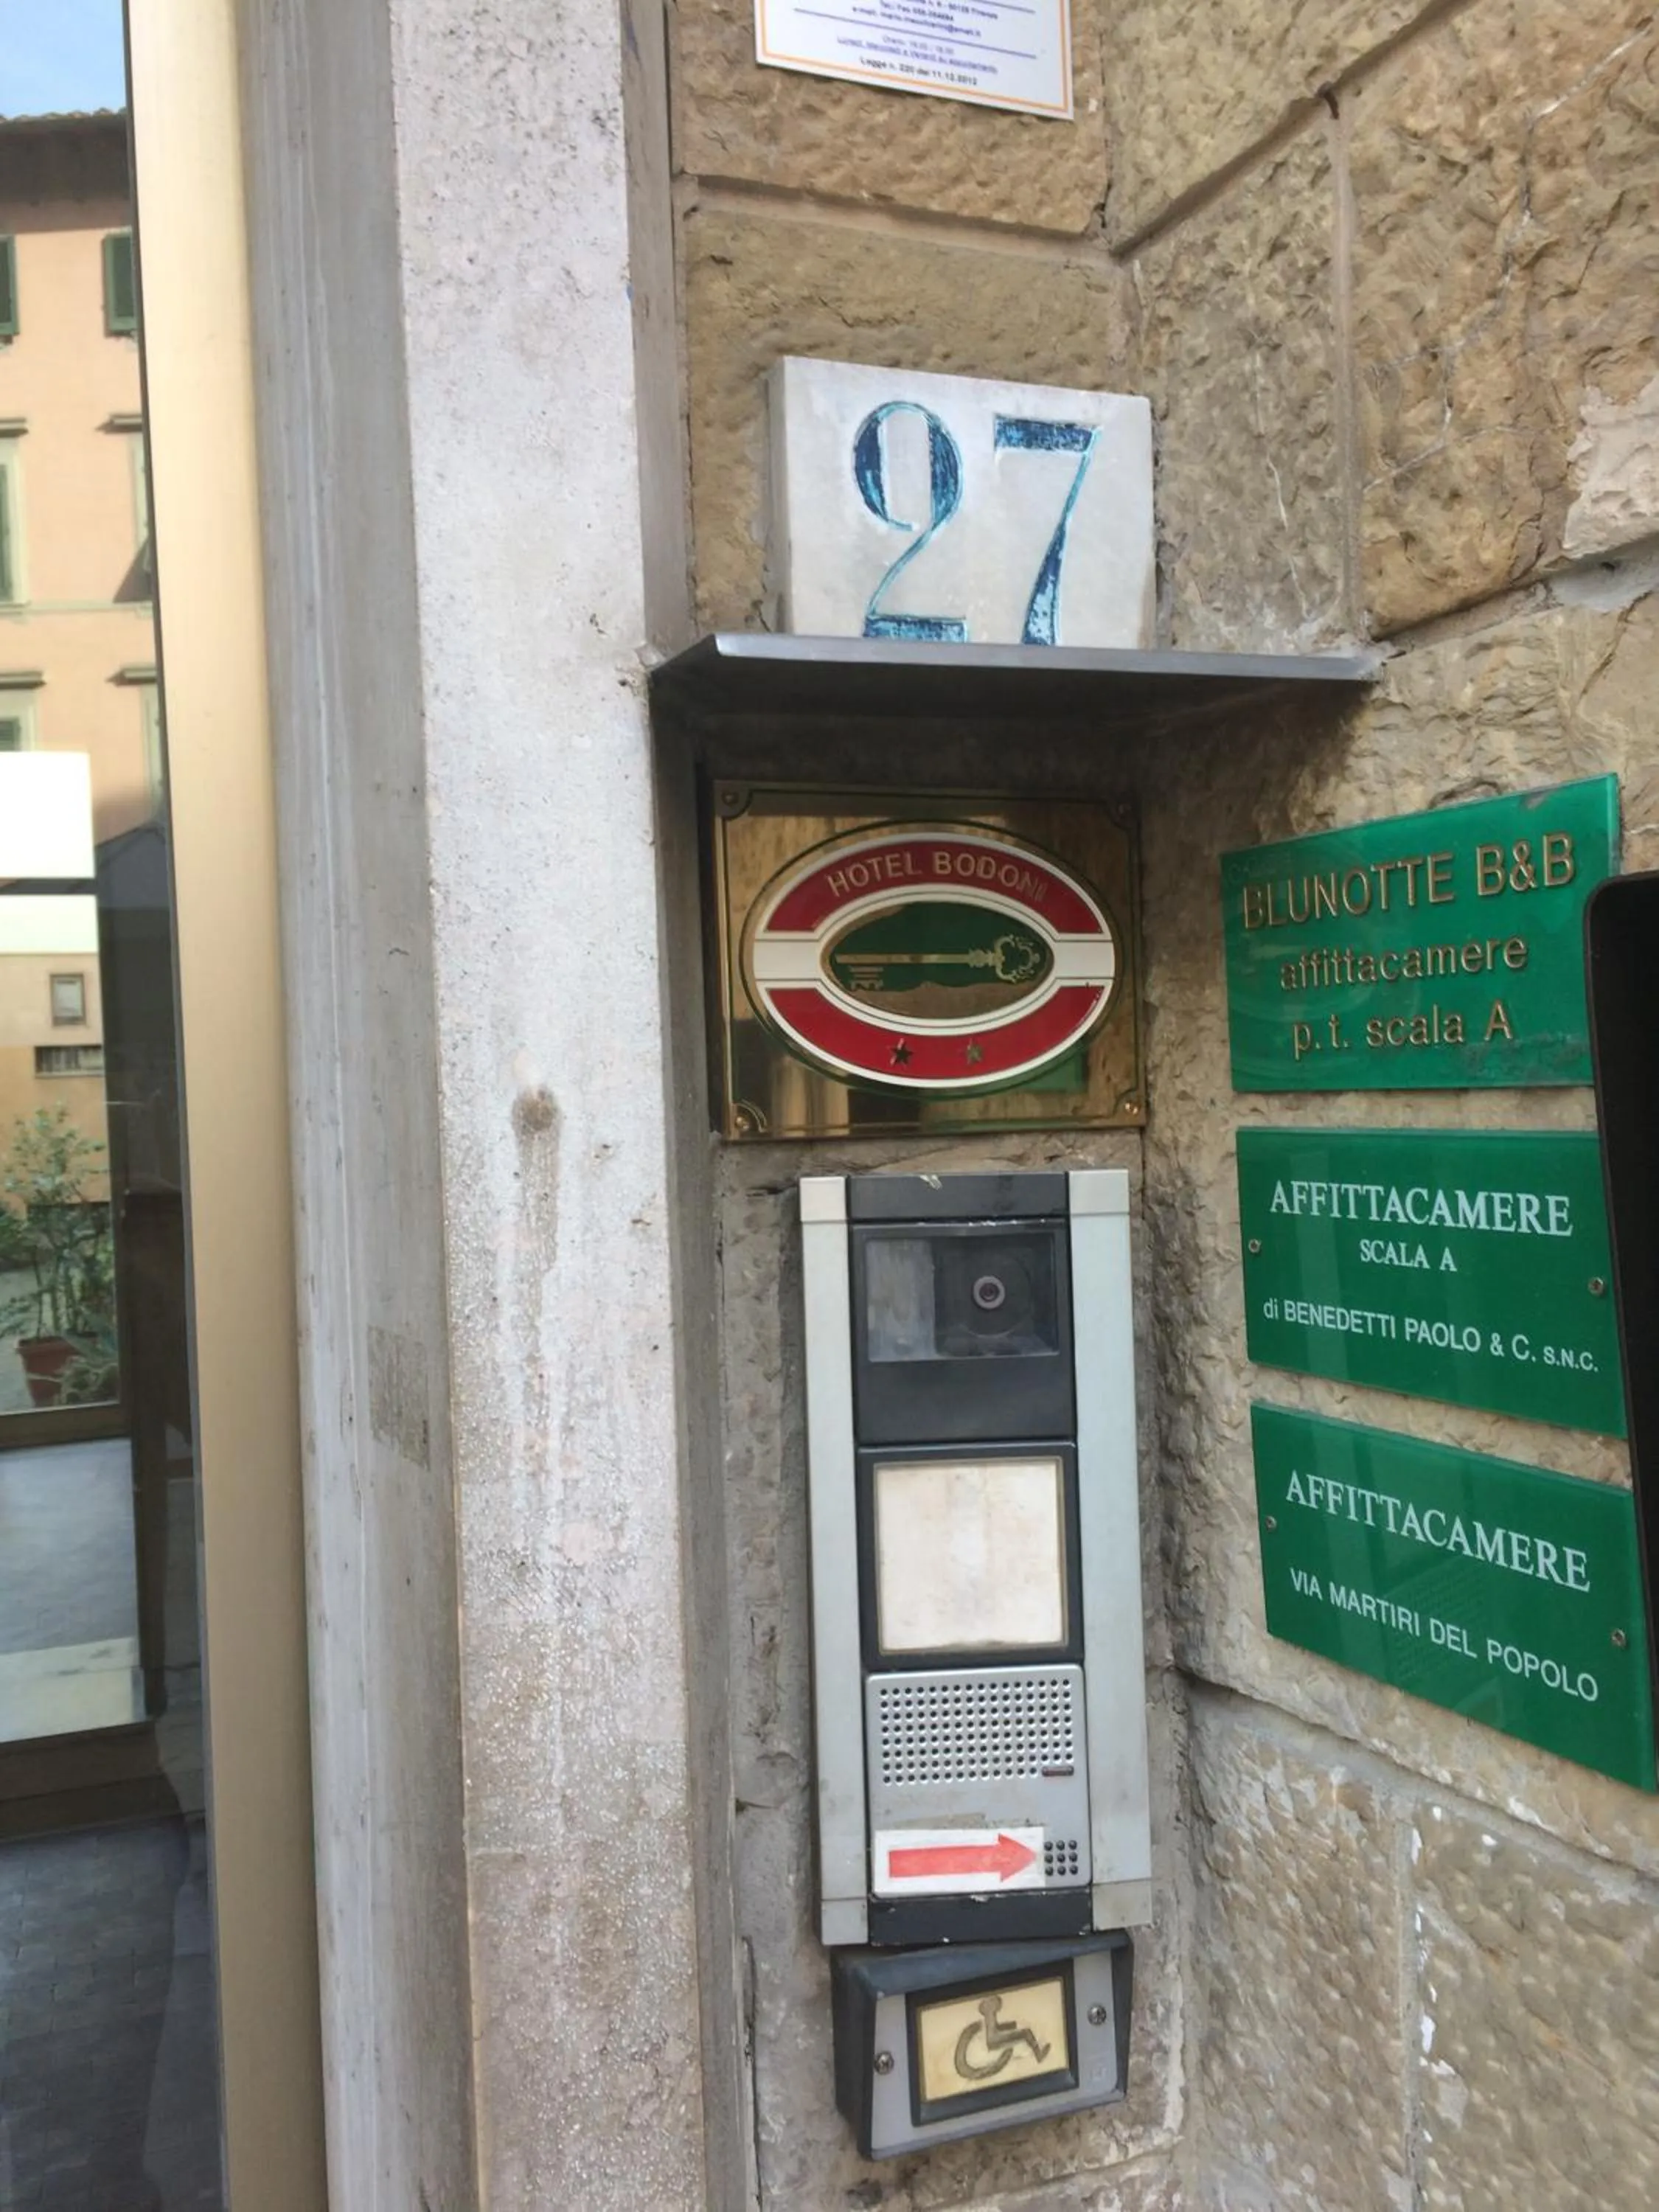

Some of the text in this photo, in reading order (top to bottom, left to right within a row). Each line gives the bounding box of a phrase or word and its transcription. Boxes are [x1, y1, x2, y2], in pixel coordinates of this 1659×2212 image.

[852, 400, 1102, 647] 27
[826, 850, 1047, 902] HOTEL BODONI
[1242, 831, 1576, 931] BLUNOTTE B&B
[1279, 933, 1529, 991] affittacamere
[1293, 998, 1514, 1060] p.t. scala A
[1270, 1180, 1574, 1238] AFFITTACAMERE
[1359, 1239, 1458, 1273] SCALA A
[1263, 1298, 1599, 1373] di BENEDETTI PAOLO & C. S.N.C.
[1286, 1470, 1591, 1593] AFFITTACAMERE
[1290, 1568, 1599, 1703] VIA MARTIRI DEL POPOLO
